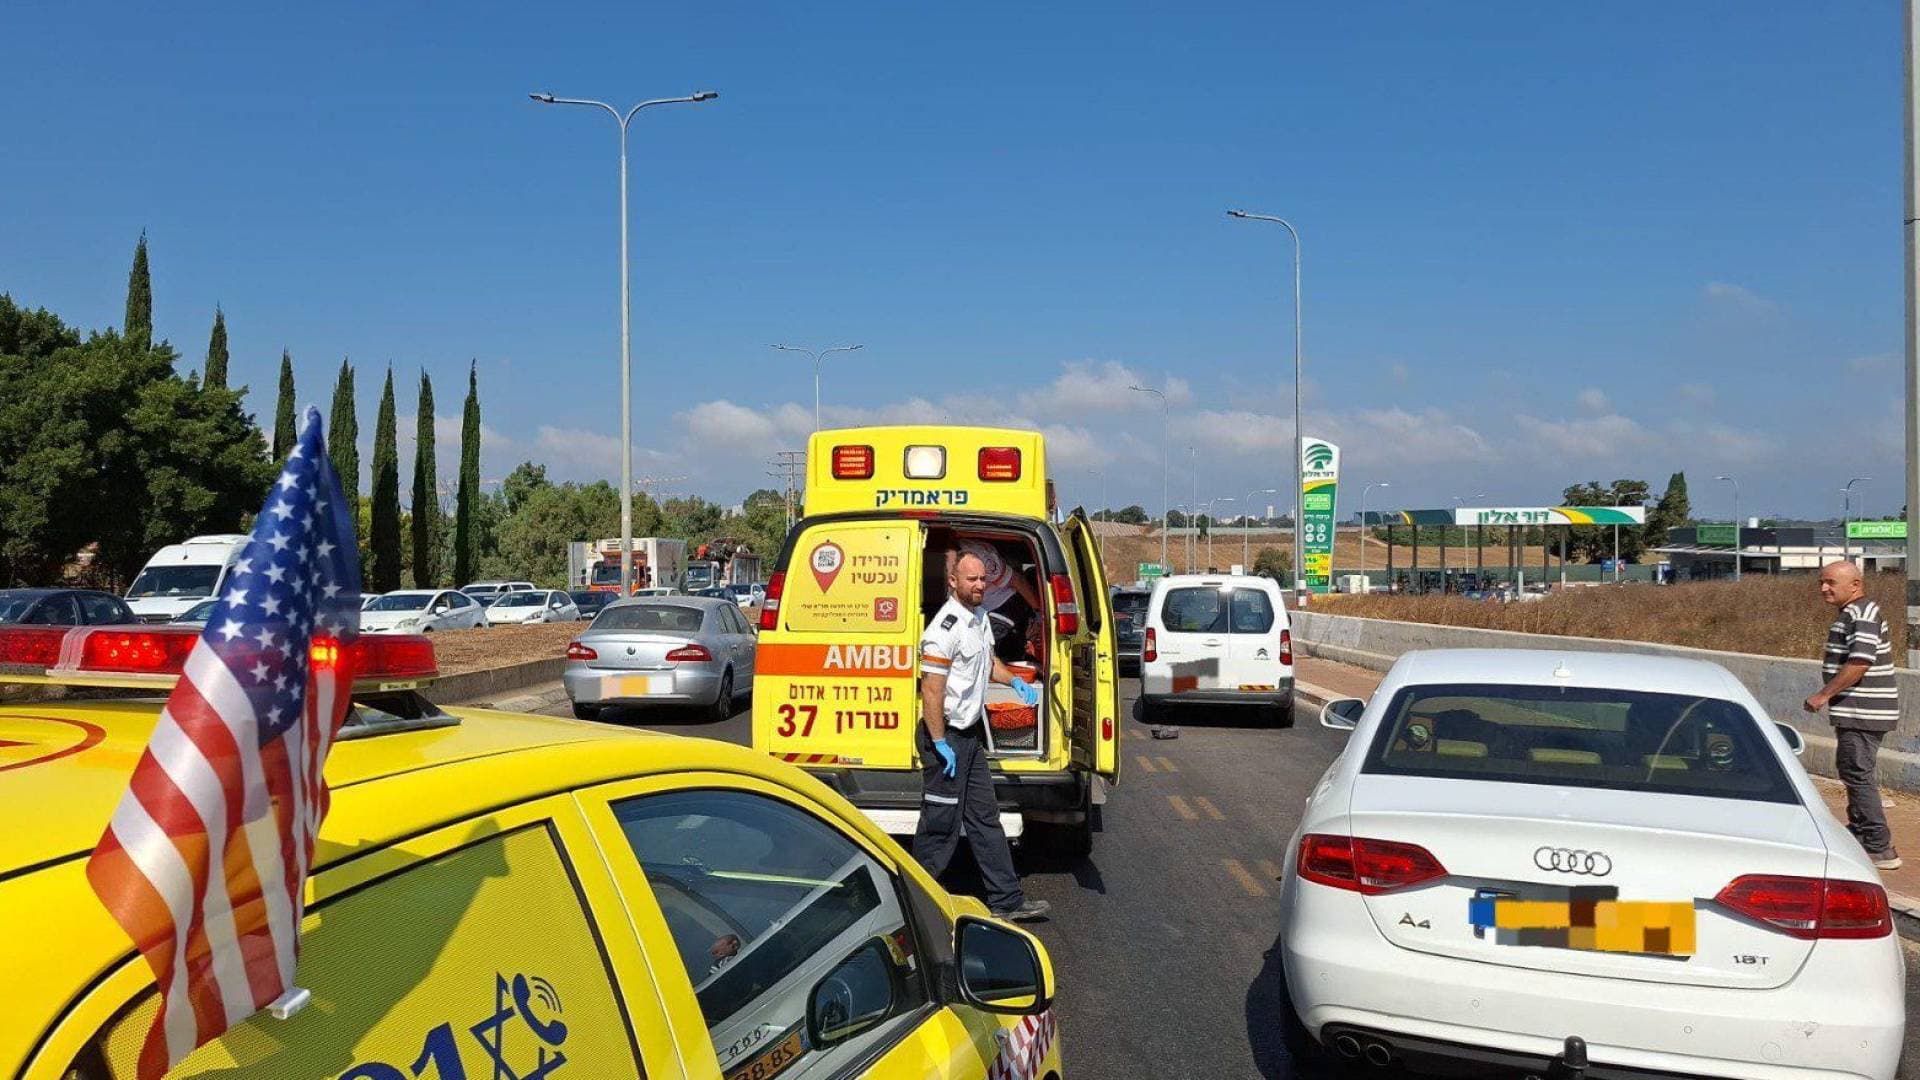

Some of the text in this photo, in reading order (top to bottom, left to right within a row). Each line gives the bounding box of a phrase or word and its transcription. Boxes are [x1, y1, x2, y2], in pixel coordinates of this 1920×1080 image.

[876, 490, 969, 507] פראמדיק
[1478, 510, 1550, 524] דור אלון
[852, 556, 899, 567] הורידו
[851, 572, 898, 585] עכשיו
[823, 645, 912, 670] AMBU
[789, 683, 892, 704] מגן דוד אדום
[777, 703, 899, 737] שרון 37
[1398, 911, 1431, 930] A4
